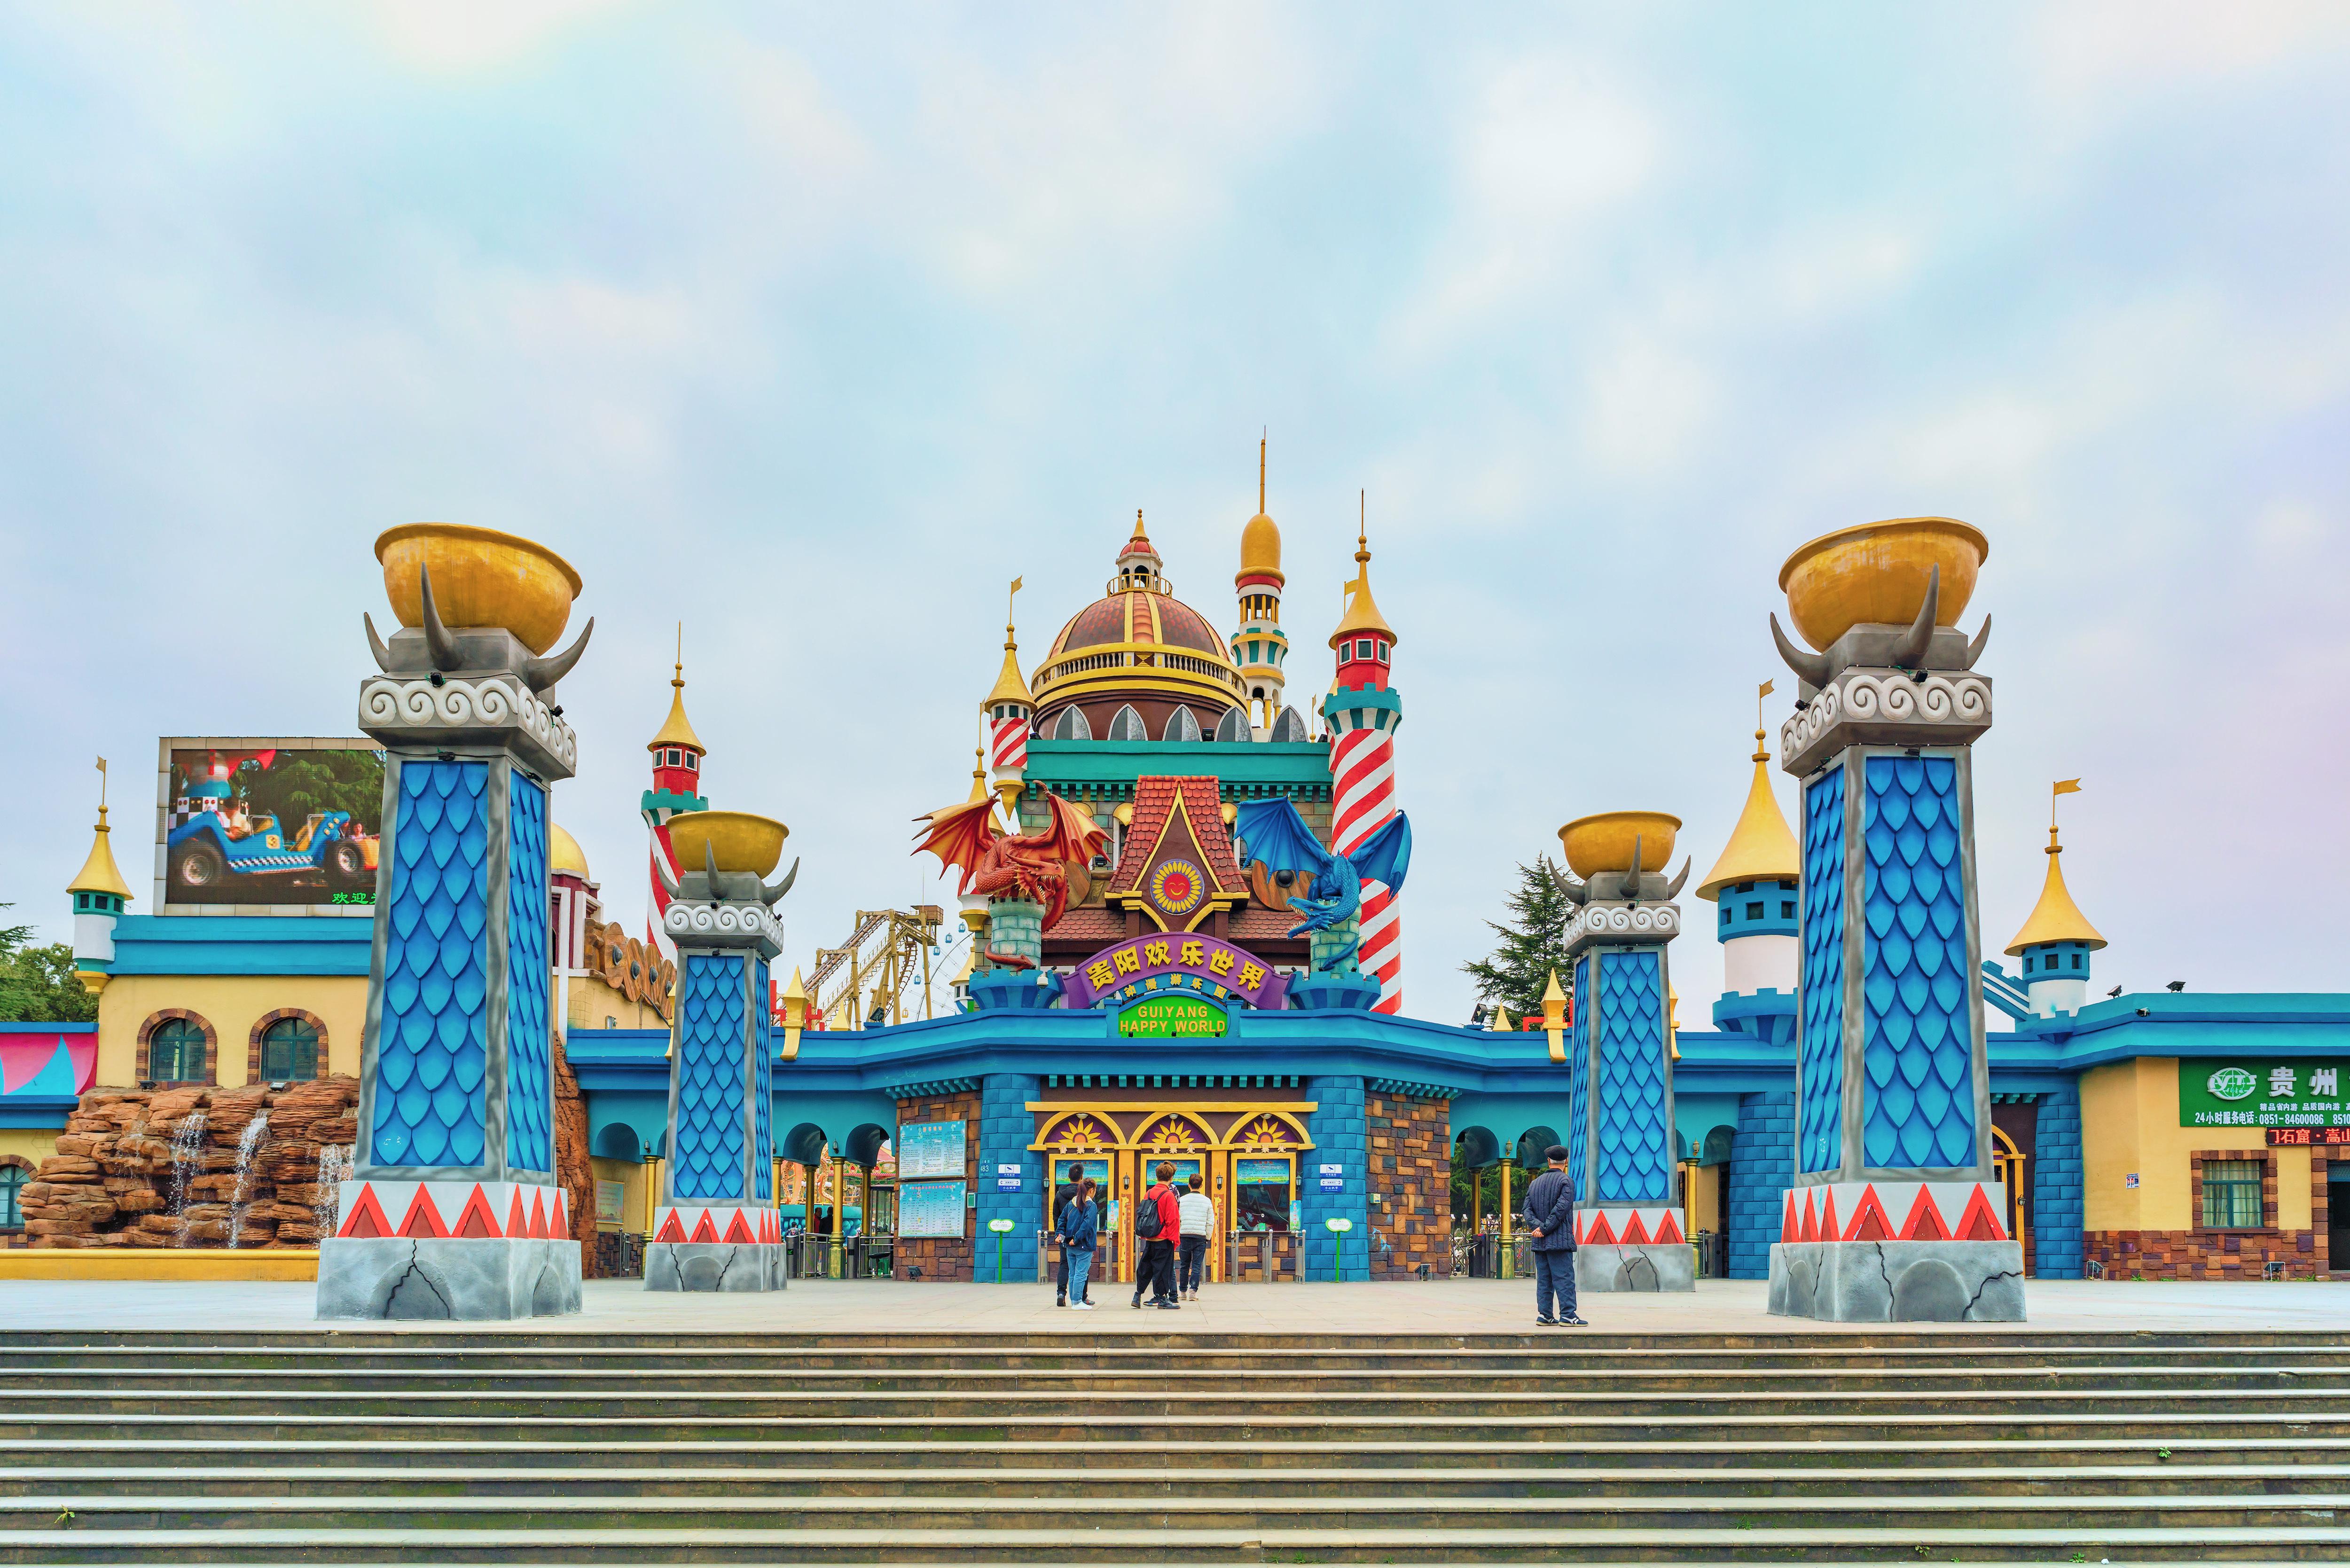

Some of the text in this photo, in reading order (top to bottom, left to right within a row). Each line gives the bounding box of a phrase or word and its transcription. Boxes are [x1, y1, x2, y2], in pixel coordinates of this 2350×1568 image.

[1086, 940, 1266, 992] 贵阳欢乐世界
[1123, 973, 1227, 999] 动漫游乐园
[1138, 1005, 1207, 1018] GUIYANG
[1120, 1020, 1225, 1033] HAPPY WORLD
[2267, 1066, 2350, 1098] 贵州
[2259, 1103, 2298, 1111] 精品省内游
[2303, 1103, 2340, 1111] 品质国内游
